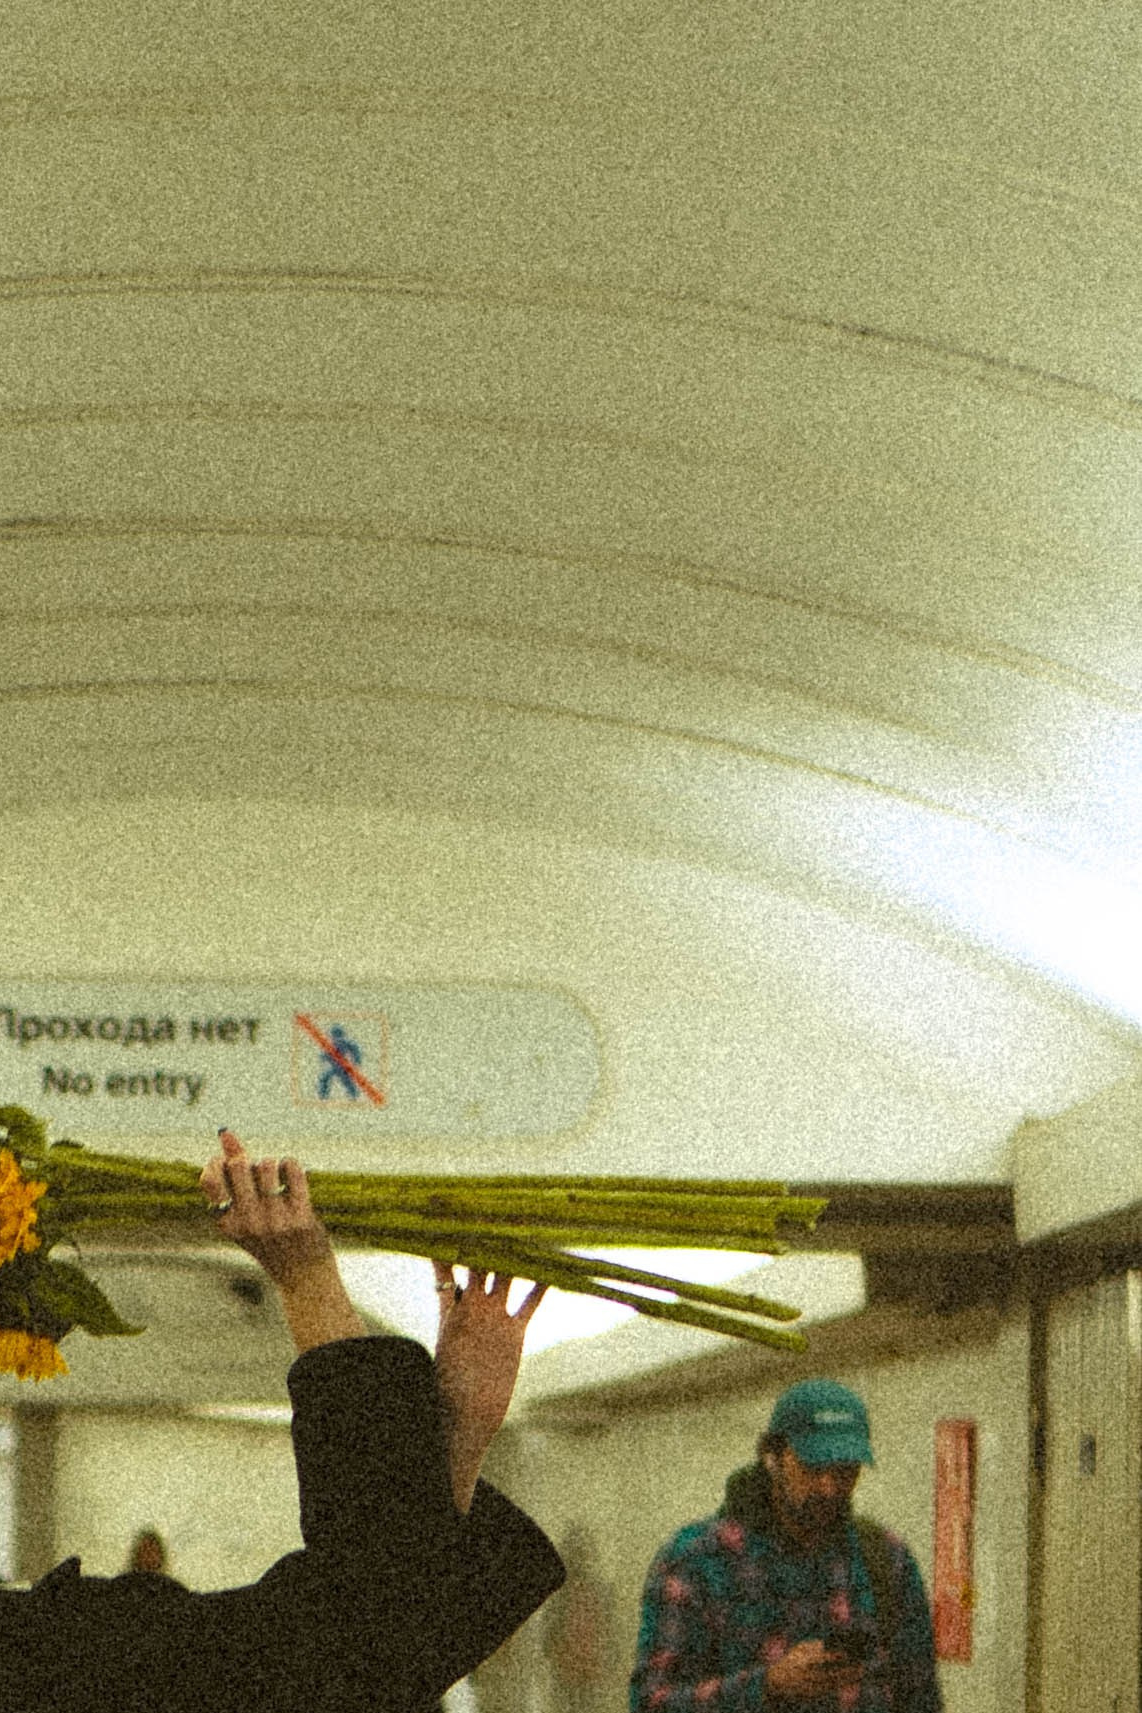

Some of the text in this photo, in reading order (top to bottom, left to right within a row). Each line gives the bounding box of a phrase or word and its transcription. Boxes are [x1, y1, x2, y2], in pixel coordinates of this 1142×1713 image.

[189, 1017, 260, 1043] нет
[42, 1066, 203, 1106] No entry
